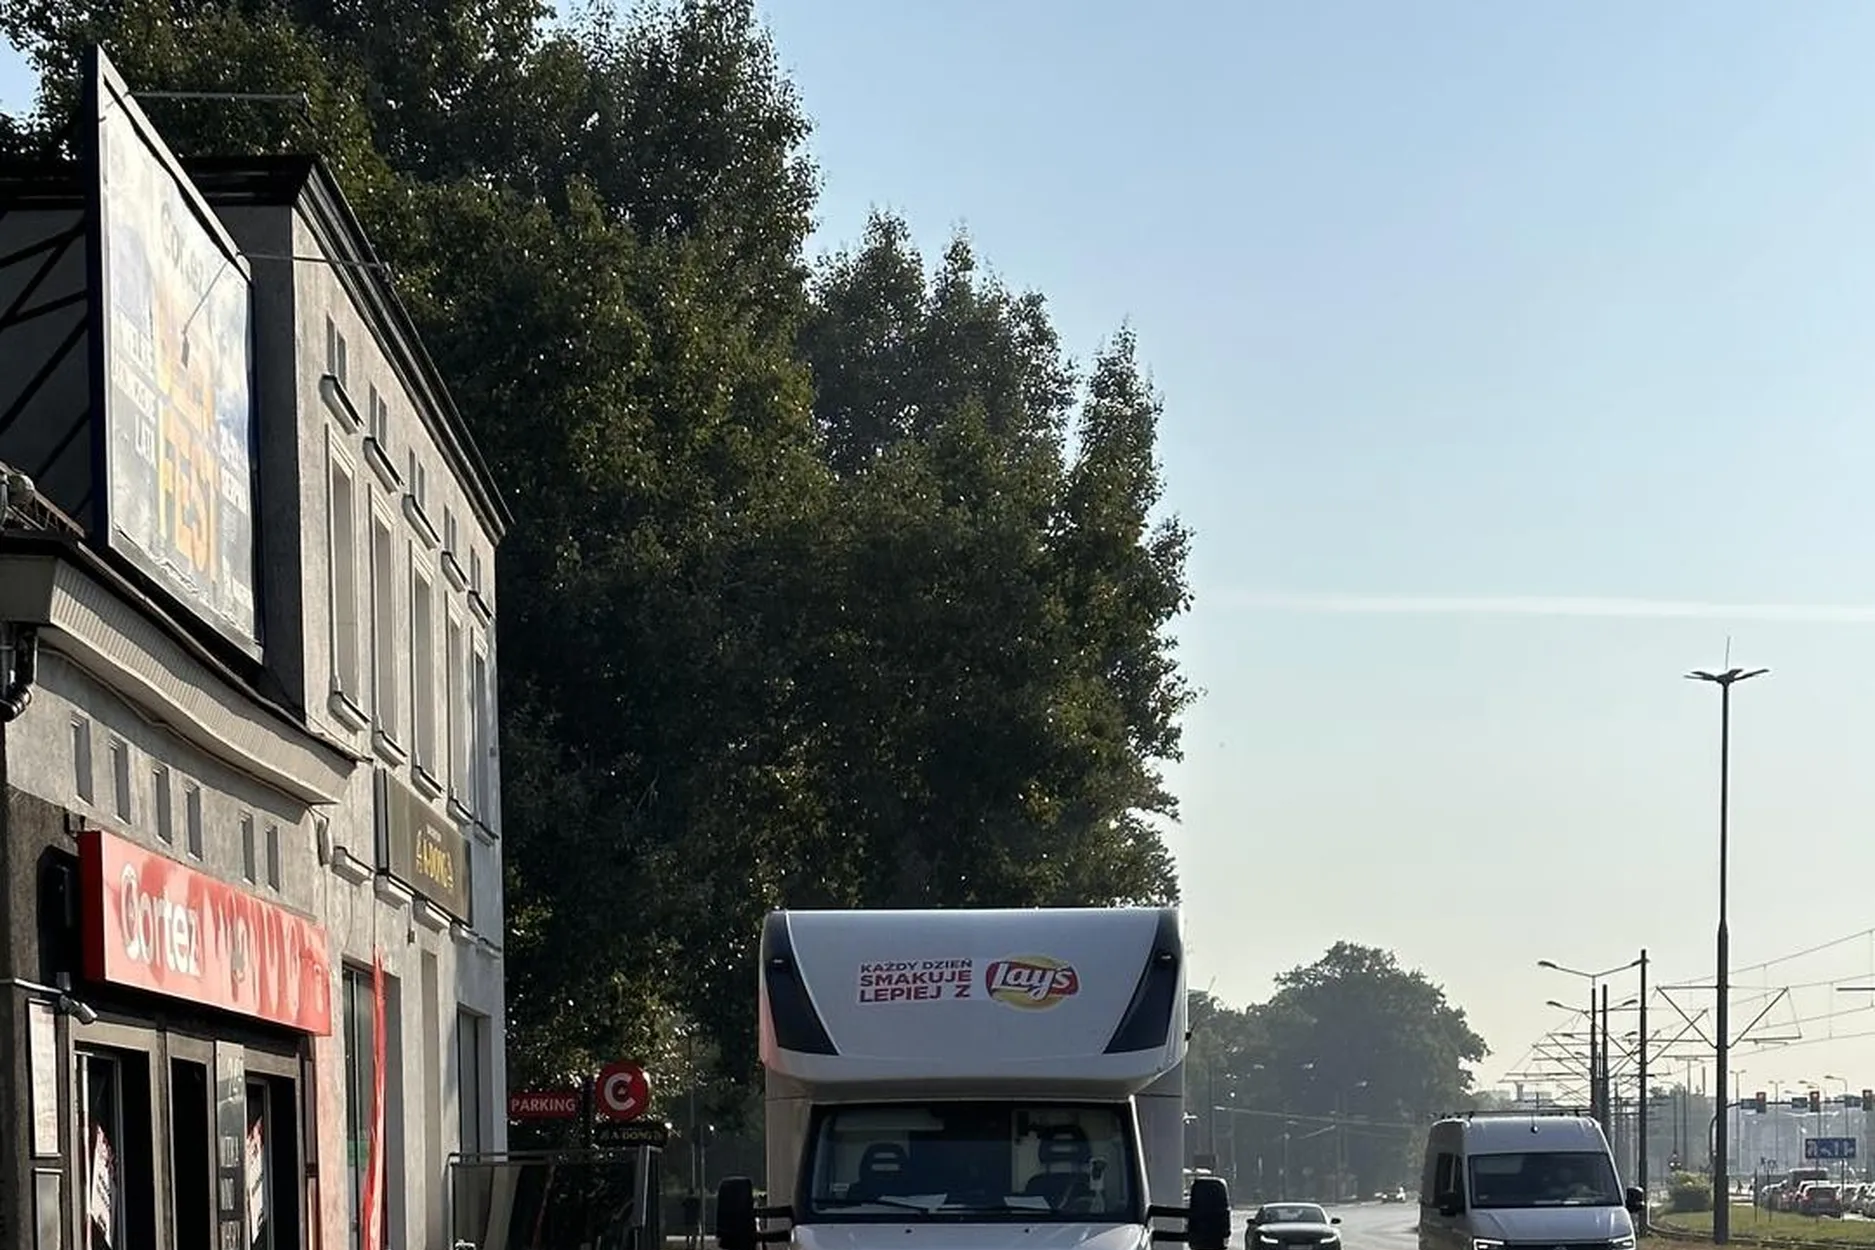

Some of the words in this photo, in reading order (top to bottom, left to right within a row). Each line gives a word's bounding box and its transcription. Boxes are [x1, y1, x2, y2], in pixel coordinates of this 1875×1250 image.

[120, 863, 202, 978] Cortez
[861, 961, 918, 973] KAŻDY
[922, 958, 973, 970] DZIEŃ
[860, 969, 973, 987] SMAKUJE
[860, 985, 942, 1003] LEPIEJ
[955, 984, 971, 998] Z
[511, 1098, 576, 1112] PARKING
